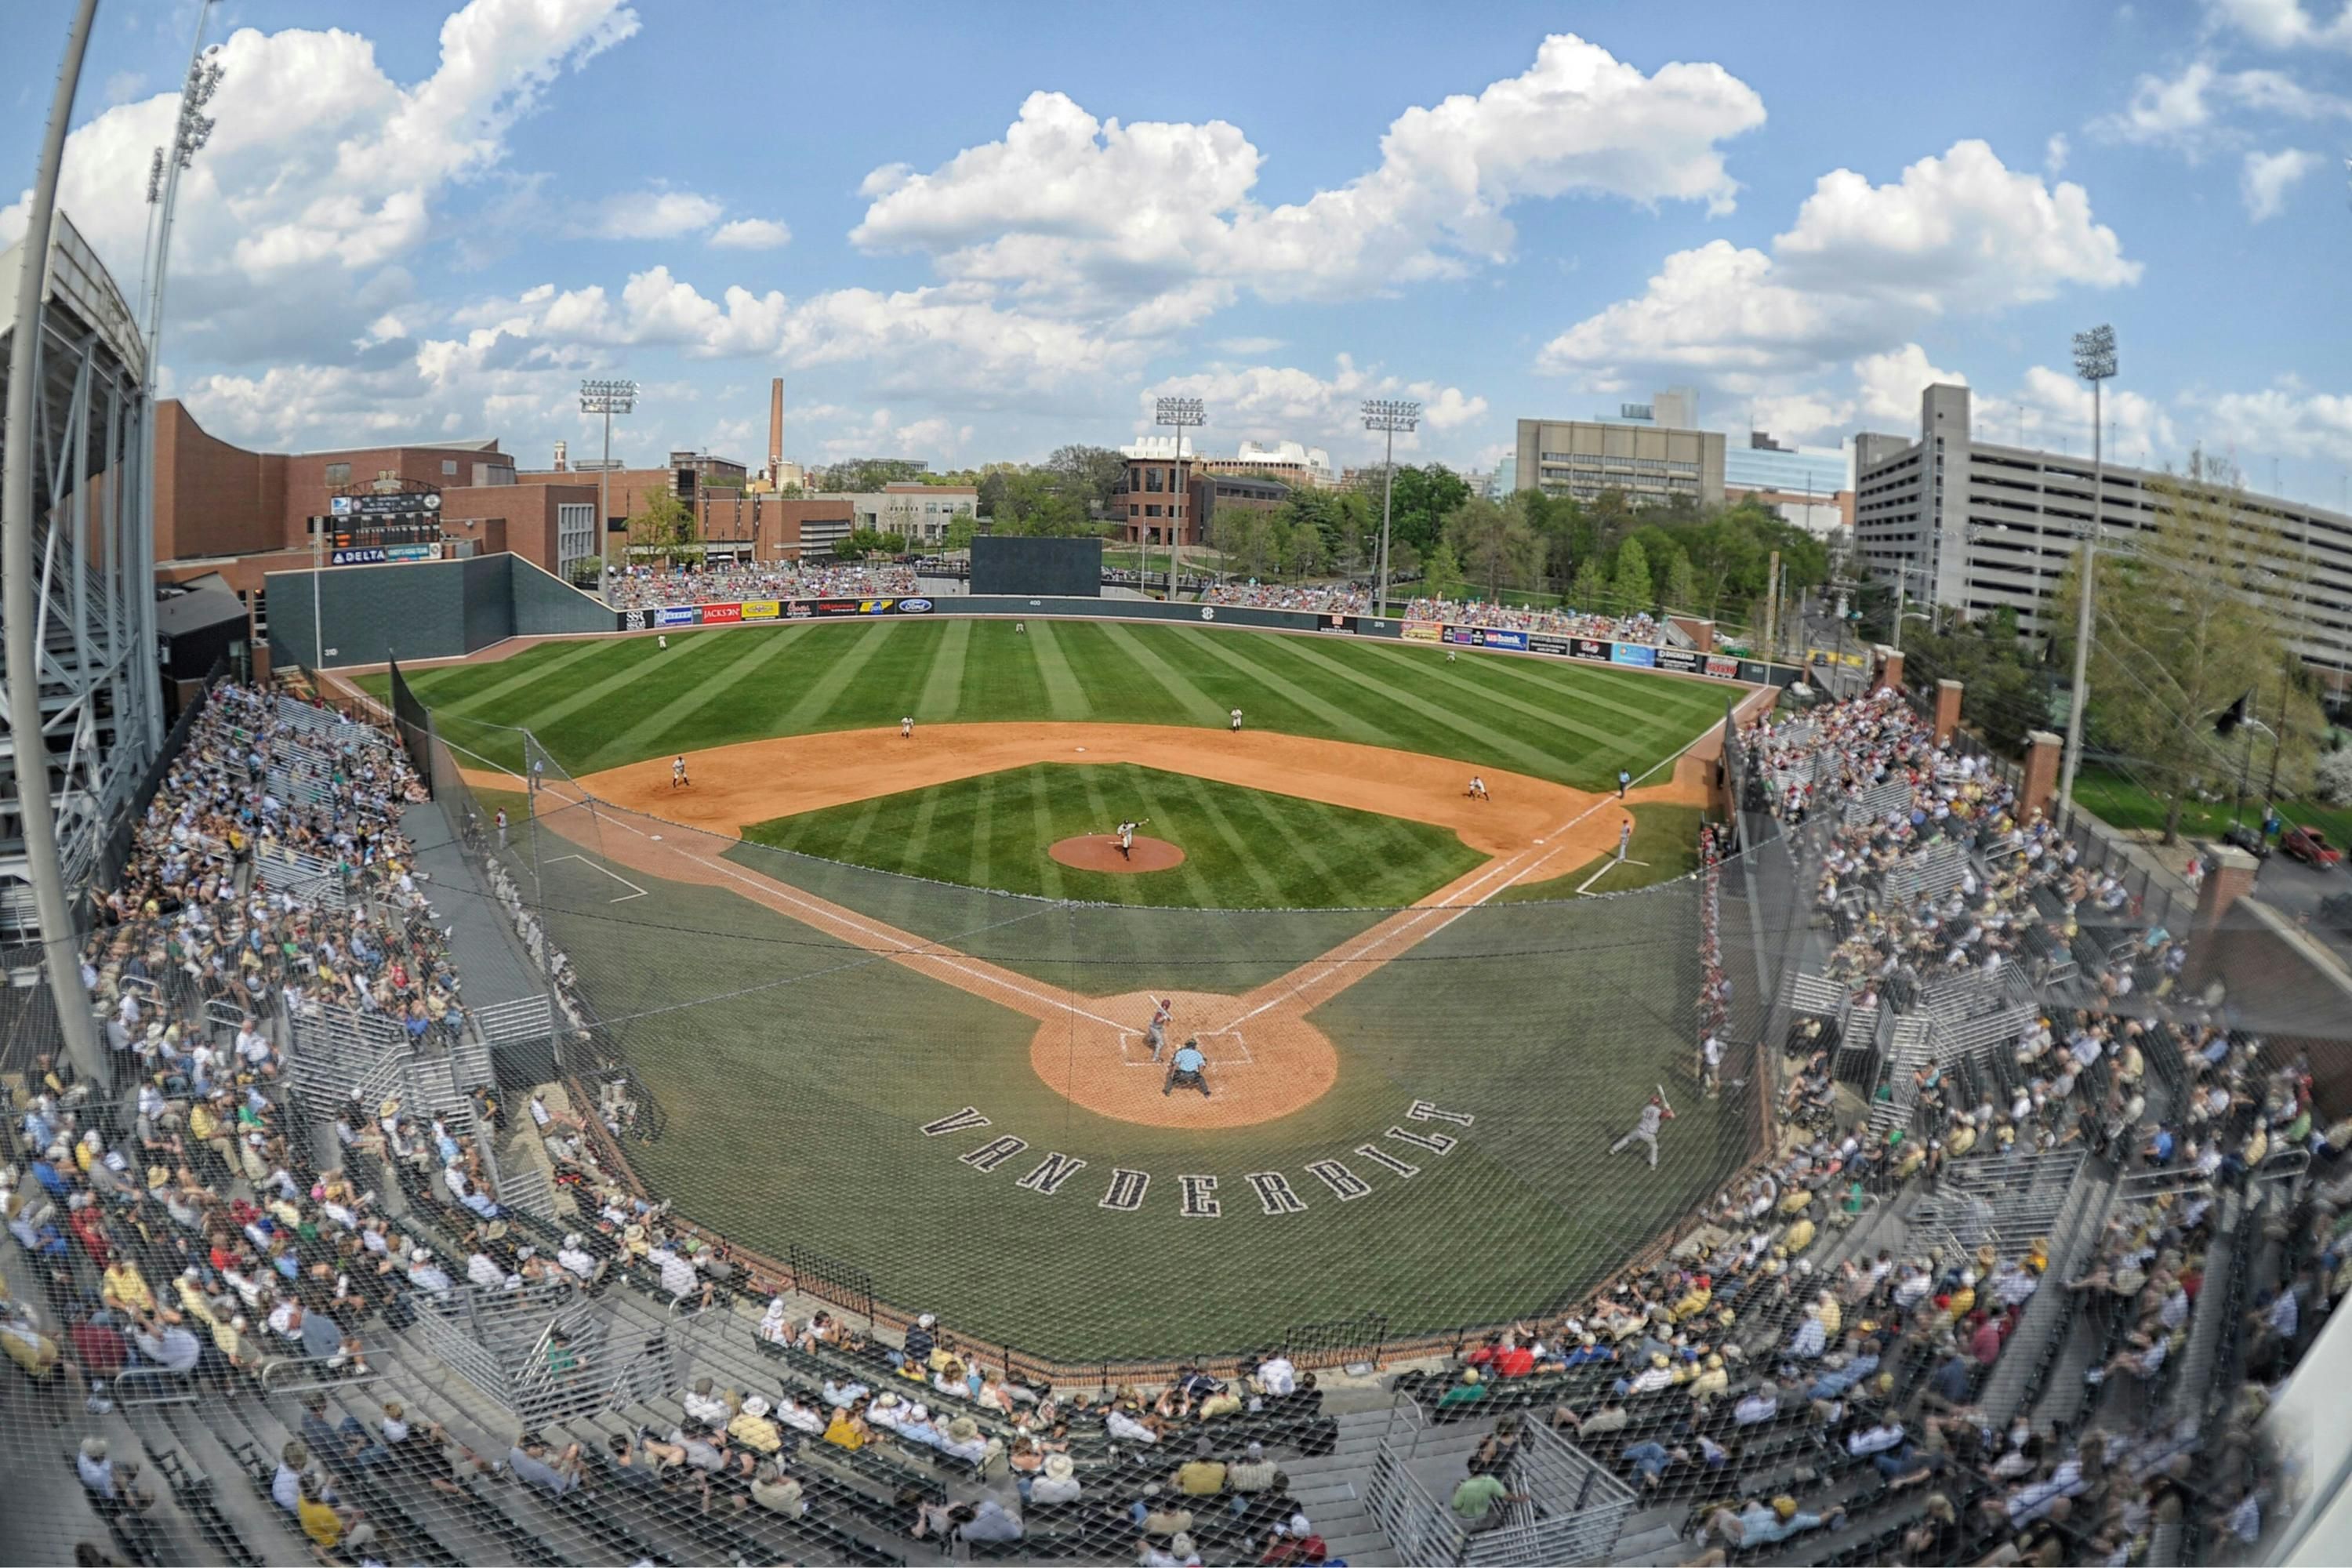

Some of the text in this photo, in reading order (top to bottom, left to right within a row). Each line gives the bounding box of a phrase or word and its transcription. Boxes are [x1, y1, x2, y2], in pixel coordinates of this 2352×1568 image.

[346, 550, 385, 562] DELTA
[704, 608, 740, 619] JACKSON
[920, 1098, 1475, 1218] VANDERBILT
